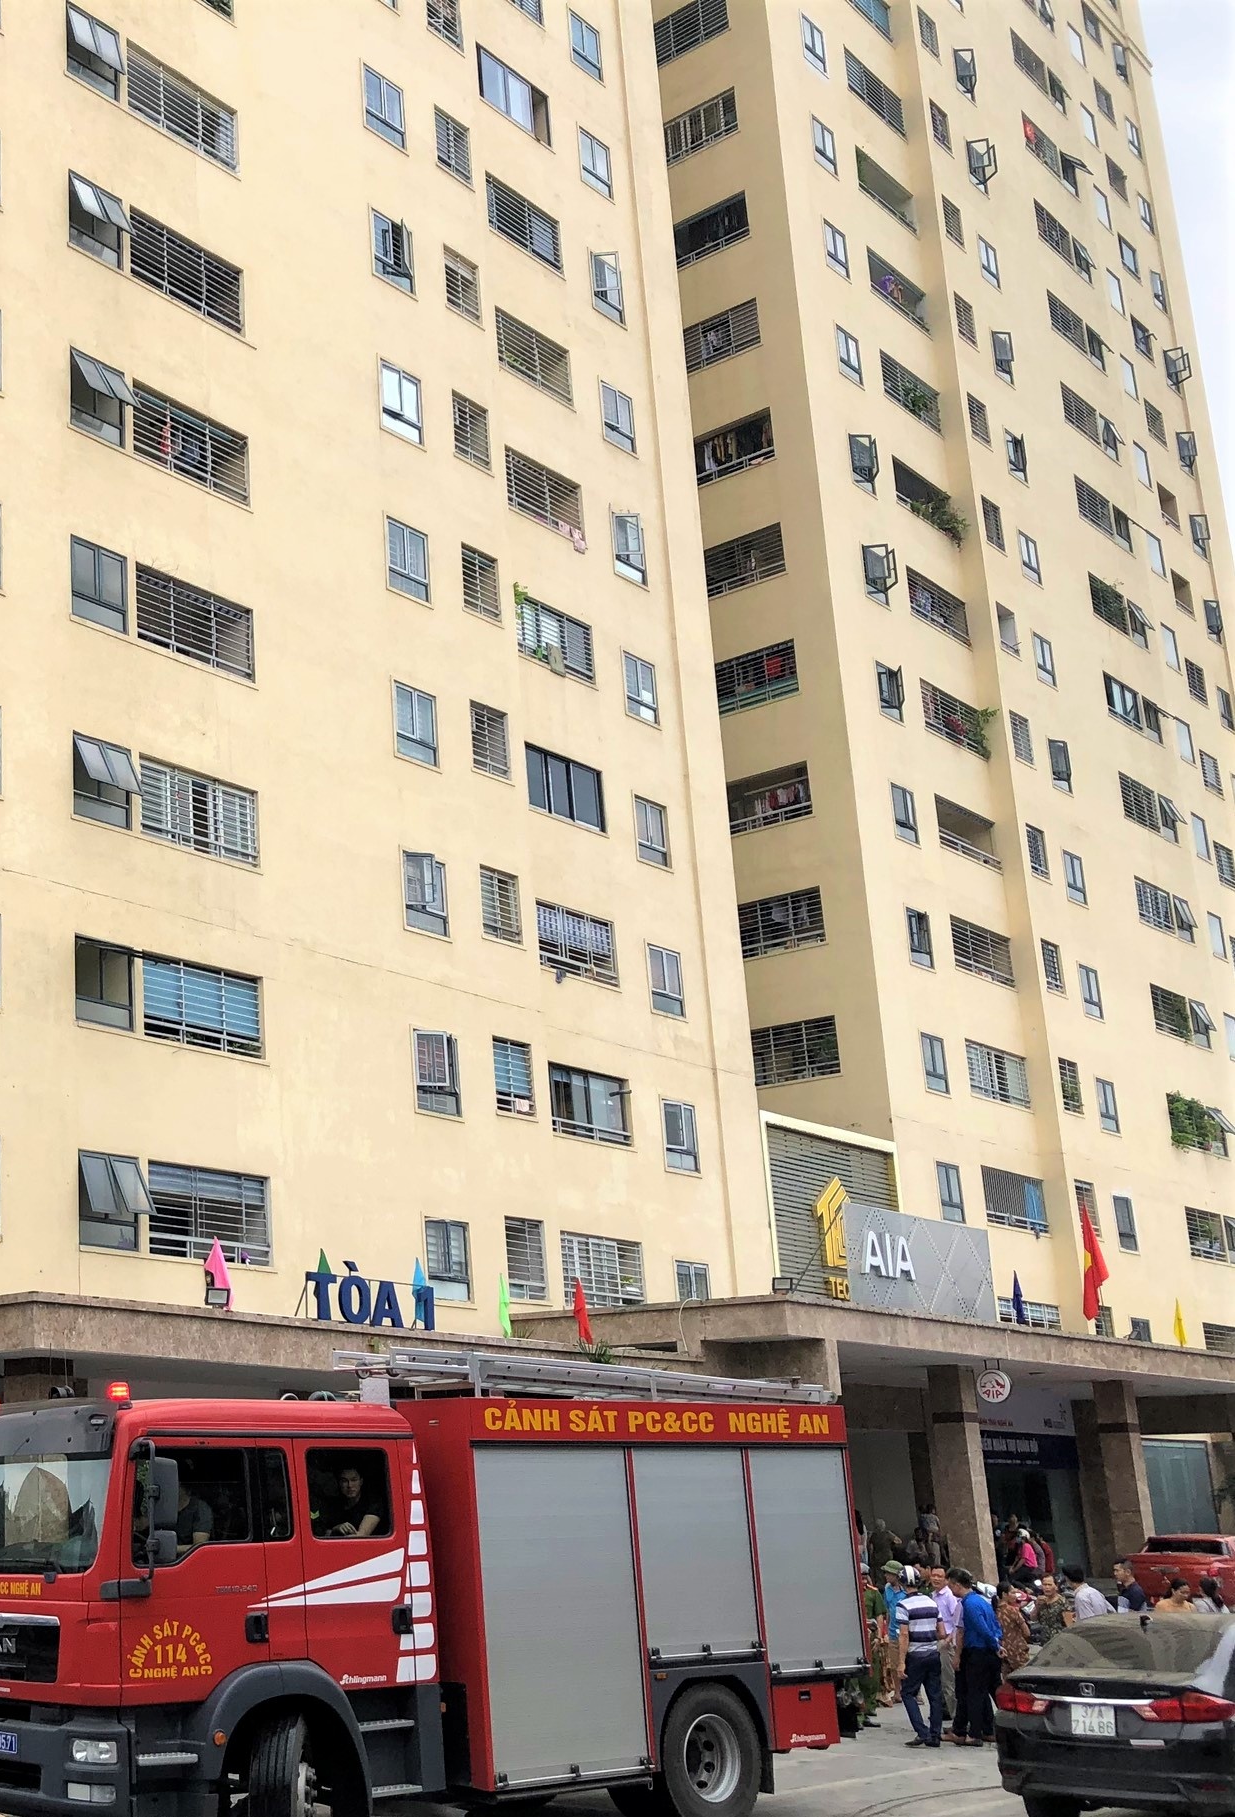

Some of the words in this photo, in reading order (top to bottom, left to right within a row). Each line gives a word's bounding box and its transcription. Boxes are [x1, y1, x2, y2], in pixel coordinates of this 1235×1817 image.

[865, 1230, 917, 1280] AIA
[306, 1260, 404, 1329] TÒA
[414, 1286, 436, 1332] 1
[982, 1388, 1004, 1399] AIA
[484, 1400, 561, 1431] CẢNH
[569, 1405, 618, 1433] SÁT
[628, 1410, 715, 1434] PC&CC
[728, 1408, 792, 1438] NGHỆ
[798, 1413, 830, 1435] AN
[10, 1580, 29, 1598] NGHỆ
[30, 1582, 42, 1596] AN
[127, 1633, 154, 1678] CẢNH
[153, 1618, 179, 1640] SÁT
[181, 1624, 213, 1675] PC&CC
[154, 1643, 187, 1664] 114
[144, 1665, 178, 1679] NGHỆ
[181, 1666, 199, 1677] AN
[1081, 1705, 1105, 1719] 37A
